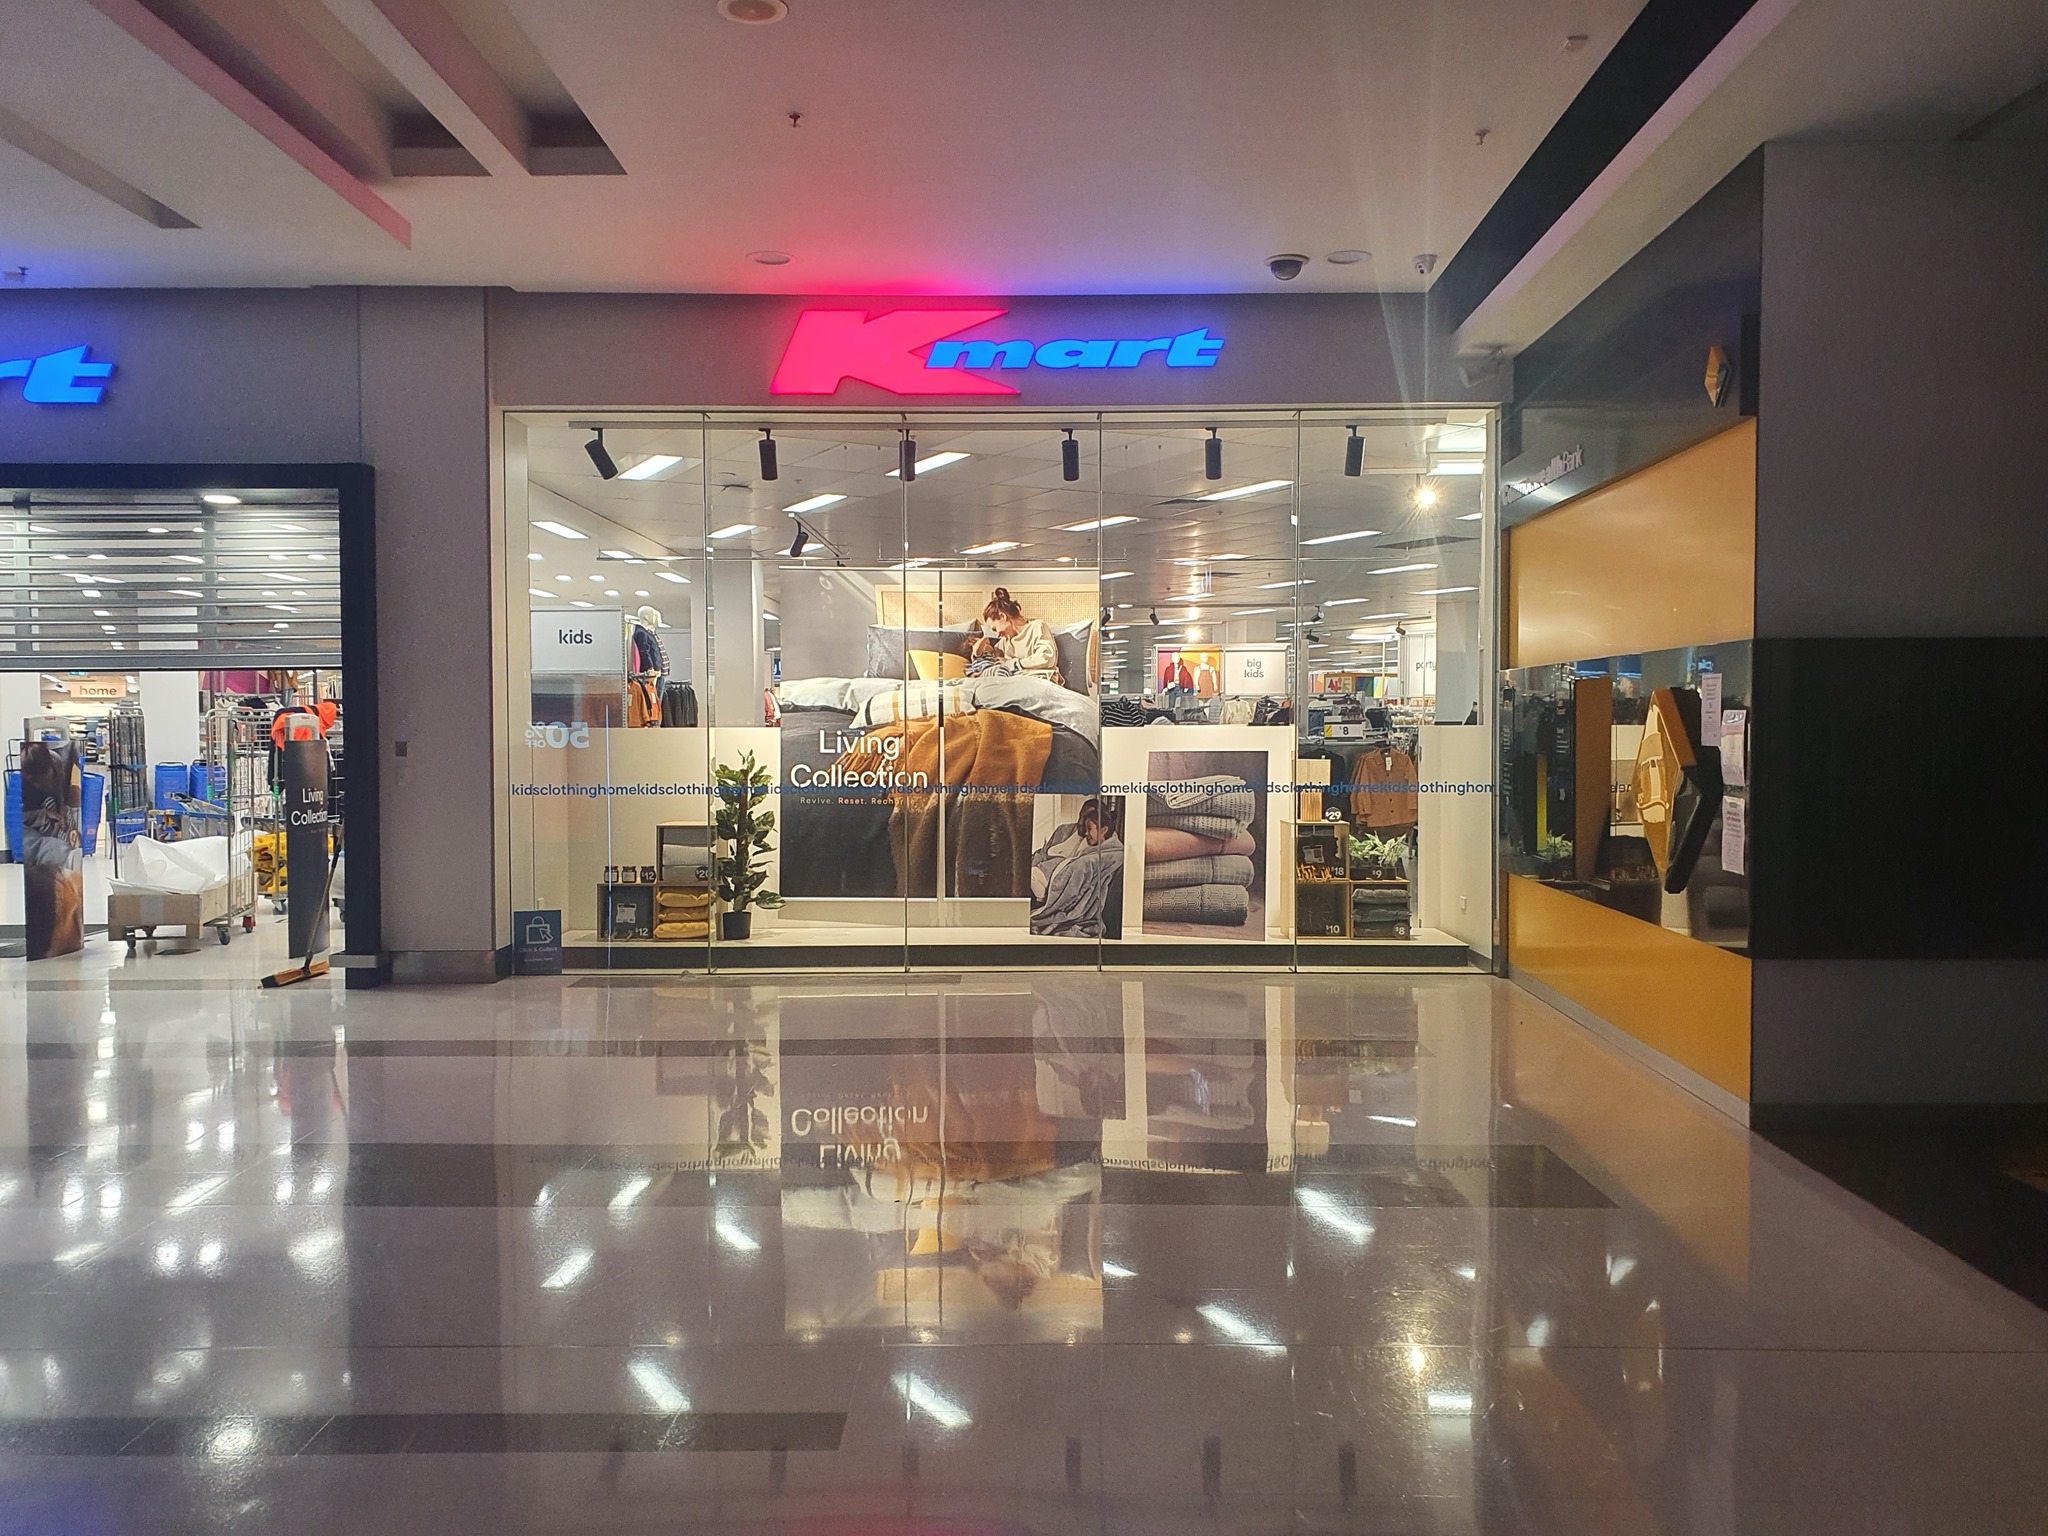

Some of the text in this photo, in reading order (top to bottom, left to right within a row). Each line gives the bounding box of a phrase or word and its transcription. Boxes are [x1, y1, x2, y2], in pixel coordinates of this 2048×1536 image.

[769, 309, 1225, 395] Kmart
[558, 629, 593, 645] kids
[1246, 658, 1262, 670] big
[1244, 669, 1265, 679] kids
[79, 685, 118, 697] home
[1339, 726, 1350, 736] $8
[819, 729, 900, 761] Living
[790, 763, 928, 789] Collection
[302, 788, 324, 805] Living
[838, 797, 868, 805] Reset.
[1325, 811, 1342, 821] $29
[641, 871, 655, 881] $12
[1331, 866, 1345, 876] $18
[1372, 869, 1382, 878] $9
[635, 927, 649, 937] $12
[1325, 925, 1340, 934] $10
[1395, 926, 1406, 935] $8
